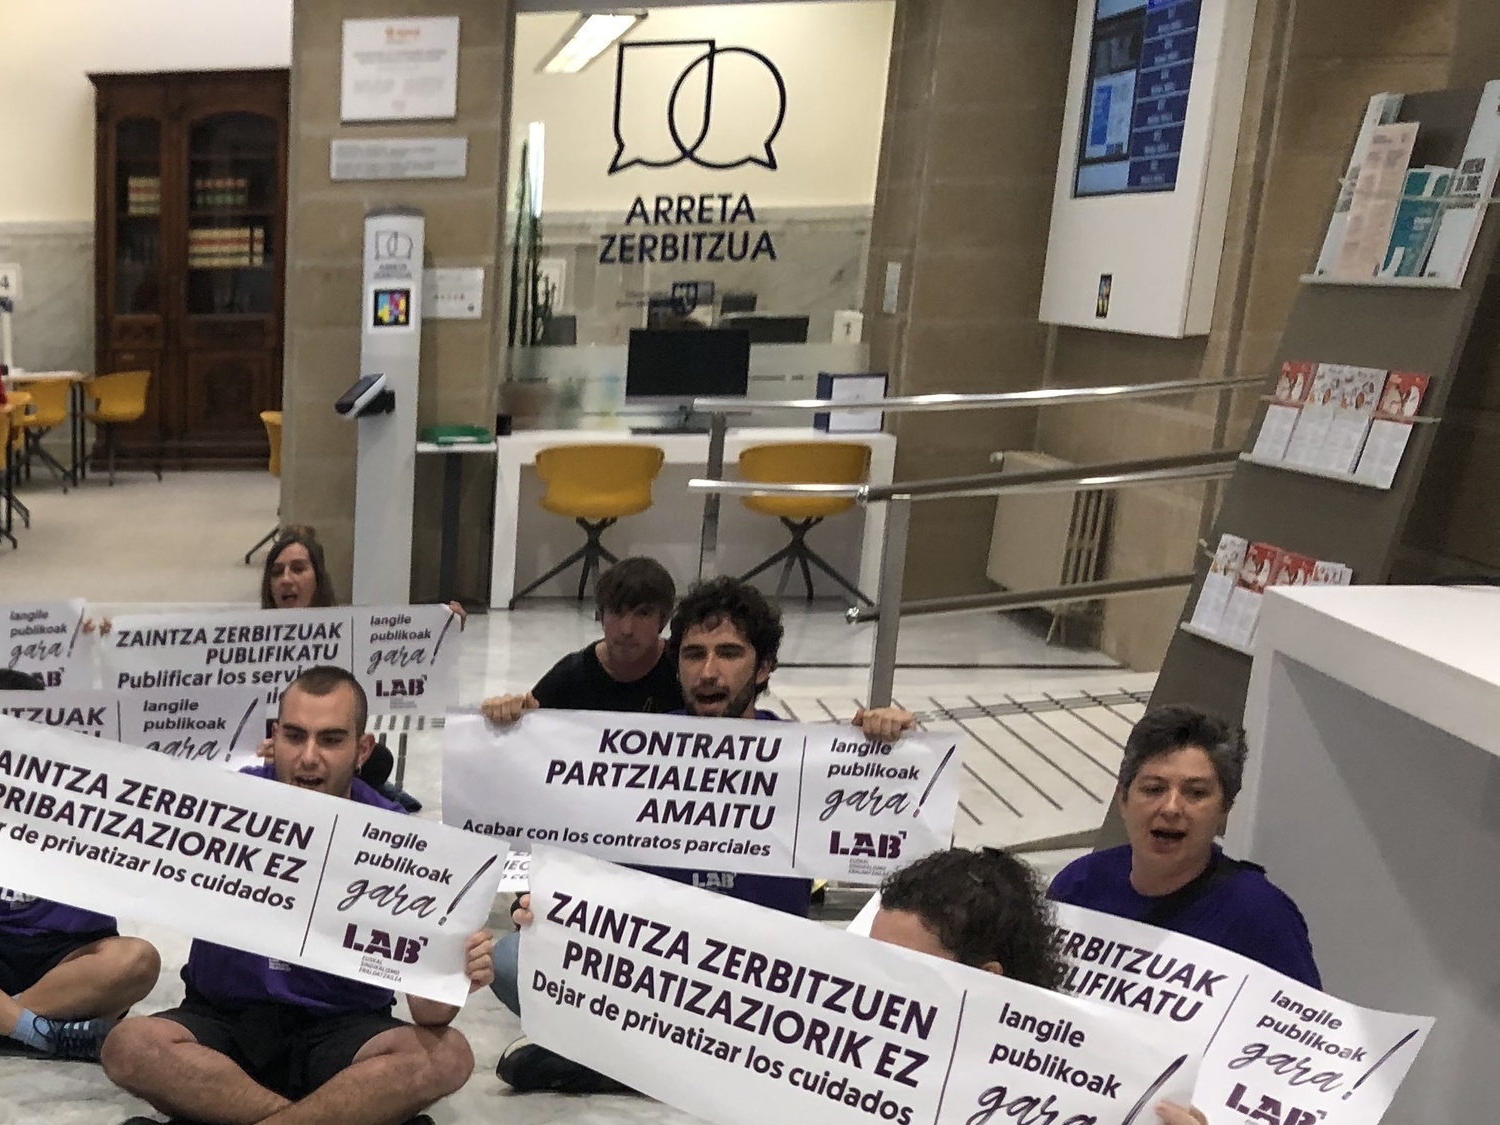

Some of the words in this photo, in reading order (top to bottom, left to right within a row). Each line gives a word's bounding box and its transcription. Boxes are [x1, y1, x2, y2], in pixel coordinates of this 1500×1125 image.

[625, 194, 755, 226] ARRETA
[599, 230, 778, 264] ZERBITZUA
[10, 610, 49, 622] langile
[10, 623, 67, 637] publikoak
[370, 614, 412, 627] langile
[116, 629, 207, 648] ZAINTZA
[212, 622, 343, 644] ZERBITZUAK
[370, 628, 432, 643] publikoak
[206, 644, 339, 665] PUBLIFIKATU
[118, 669, 213, 689] Publificar
[217, 667, 247, 685] los
[375, 675, 428, 698] LAB
[143, 699, 200, 713] langile
[143, 716, 227, 732] publikoak
[599, 727, 783, 763] KONTRATU
[830, 738, 892, 757] langile
[545, 760, 779, 797] PARTZIALEKIN
[827, 762, 920, 781] publikoak
[115, 777, 315, 850] ZERBITZUEN
[636, 798, 775, 830] AMAITU
[362, 821, 428, 853] langile
[463, 818, 524, 838] Acabar
[527, 827, 559, 841] con
[563, 827, 589, 845] los
[593, 832, 682, 851] contratos
[686, 837, 772, 858] parciales
[828, 830, 907, 860] LAB
[10, 821, 39, 845] de
[41, 831, 151, 874] privatizar
[154, 857, 187, 883] los
[190, 867, 296, 911] cuidados
[263, 853, 308, 884] EZ
[354, 849, 454, 886] publikoak
[342, 922, 429, 965] LAB
[546, 891, 693, 966] ZAINTZA
[697, 937, 939, 1040] ZERBITZUEN
[1052, 927, 1229, 999] ERBITZUAK
[532, 969, 587, 1012] Dejar
[590, 989, 620, 1021] de
[622, 1005, 742, 1066] privatizar
[745, 1045, 784, 1080] los
[562, 940, 863, 1069] PRIBATIZAZIORIK
[876, 1046, 930, 1089] EZ
[999, 1003, 1086, 1048] langile
[1271, 990, 1343, 1030] langile
[1256, 1014, 1368, 1063] publikoak
[989, 1041, 1122, 1100] publikoak
